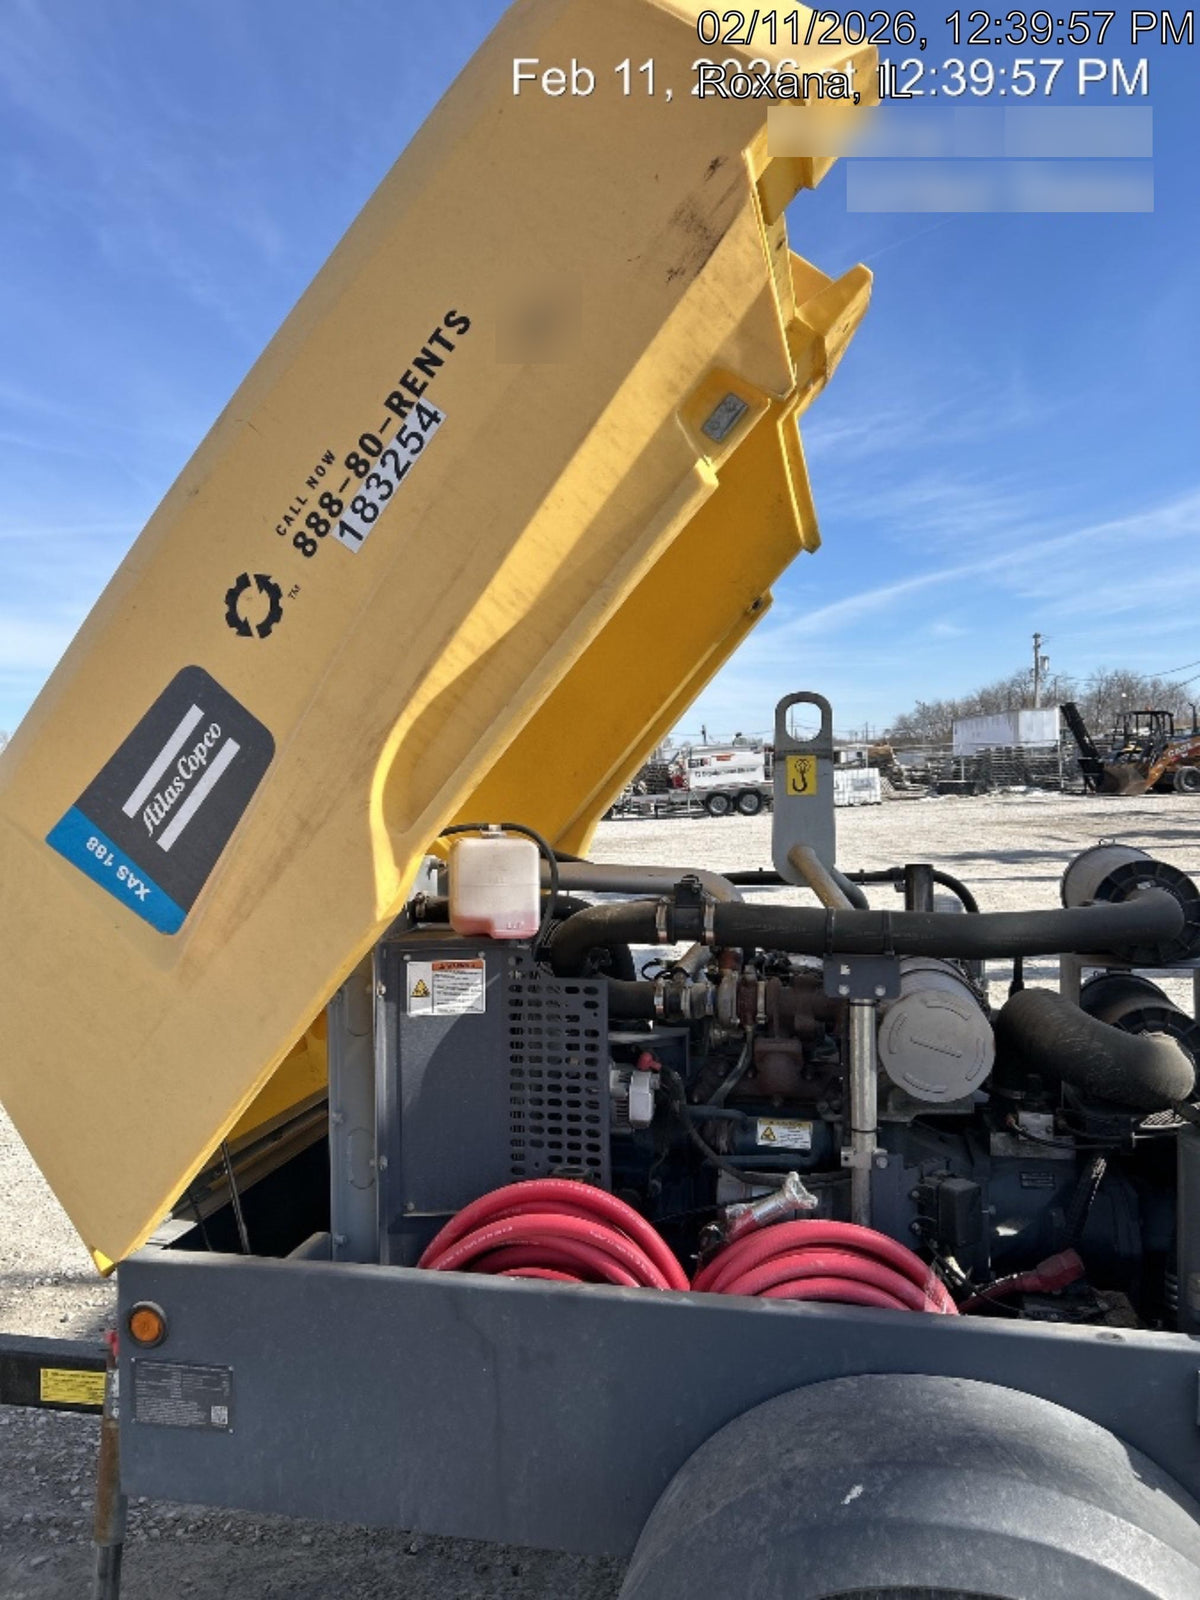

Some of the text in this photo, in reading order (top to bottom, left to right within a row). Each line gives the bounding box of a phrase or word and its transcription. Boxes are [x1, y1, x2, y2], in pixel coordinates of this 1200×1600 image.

[293, 310, 471, 557] 888-80-RENTS
[338, 402, 442, 541] 183254
[275, 450, 336, 536] CALL NOW
[142, 722, 222, 837] Atlas Copco
[86, 836, 151, 901] XAS 188
